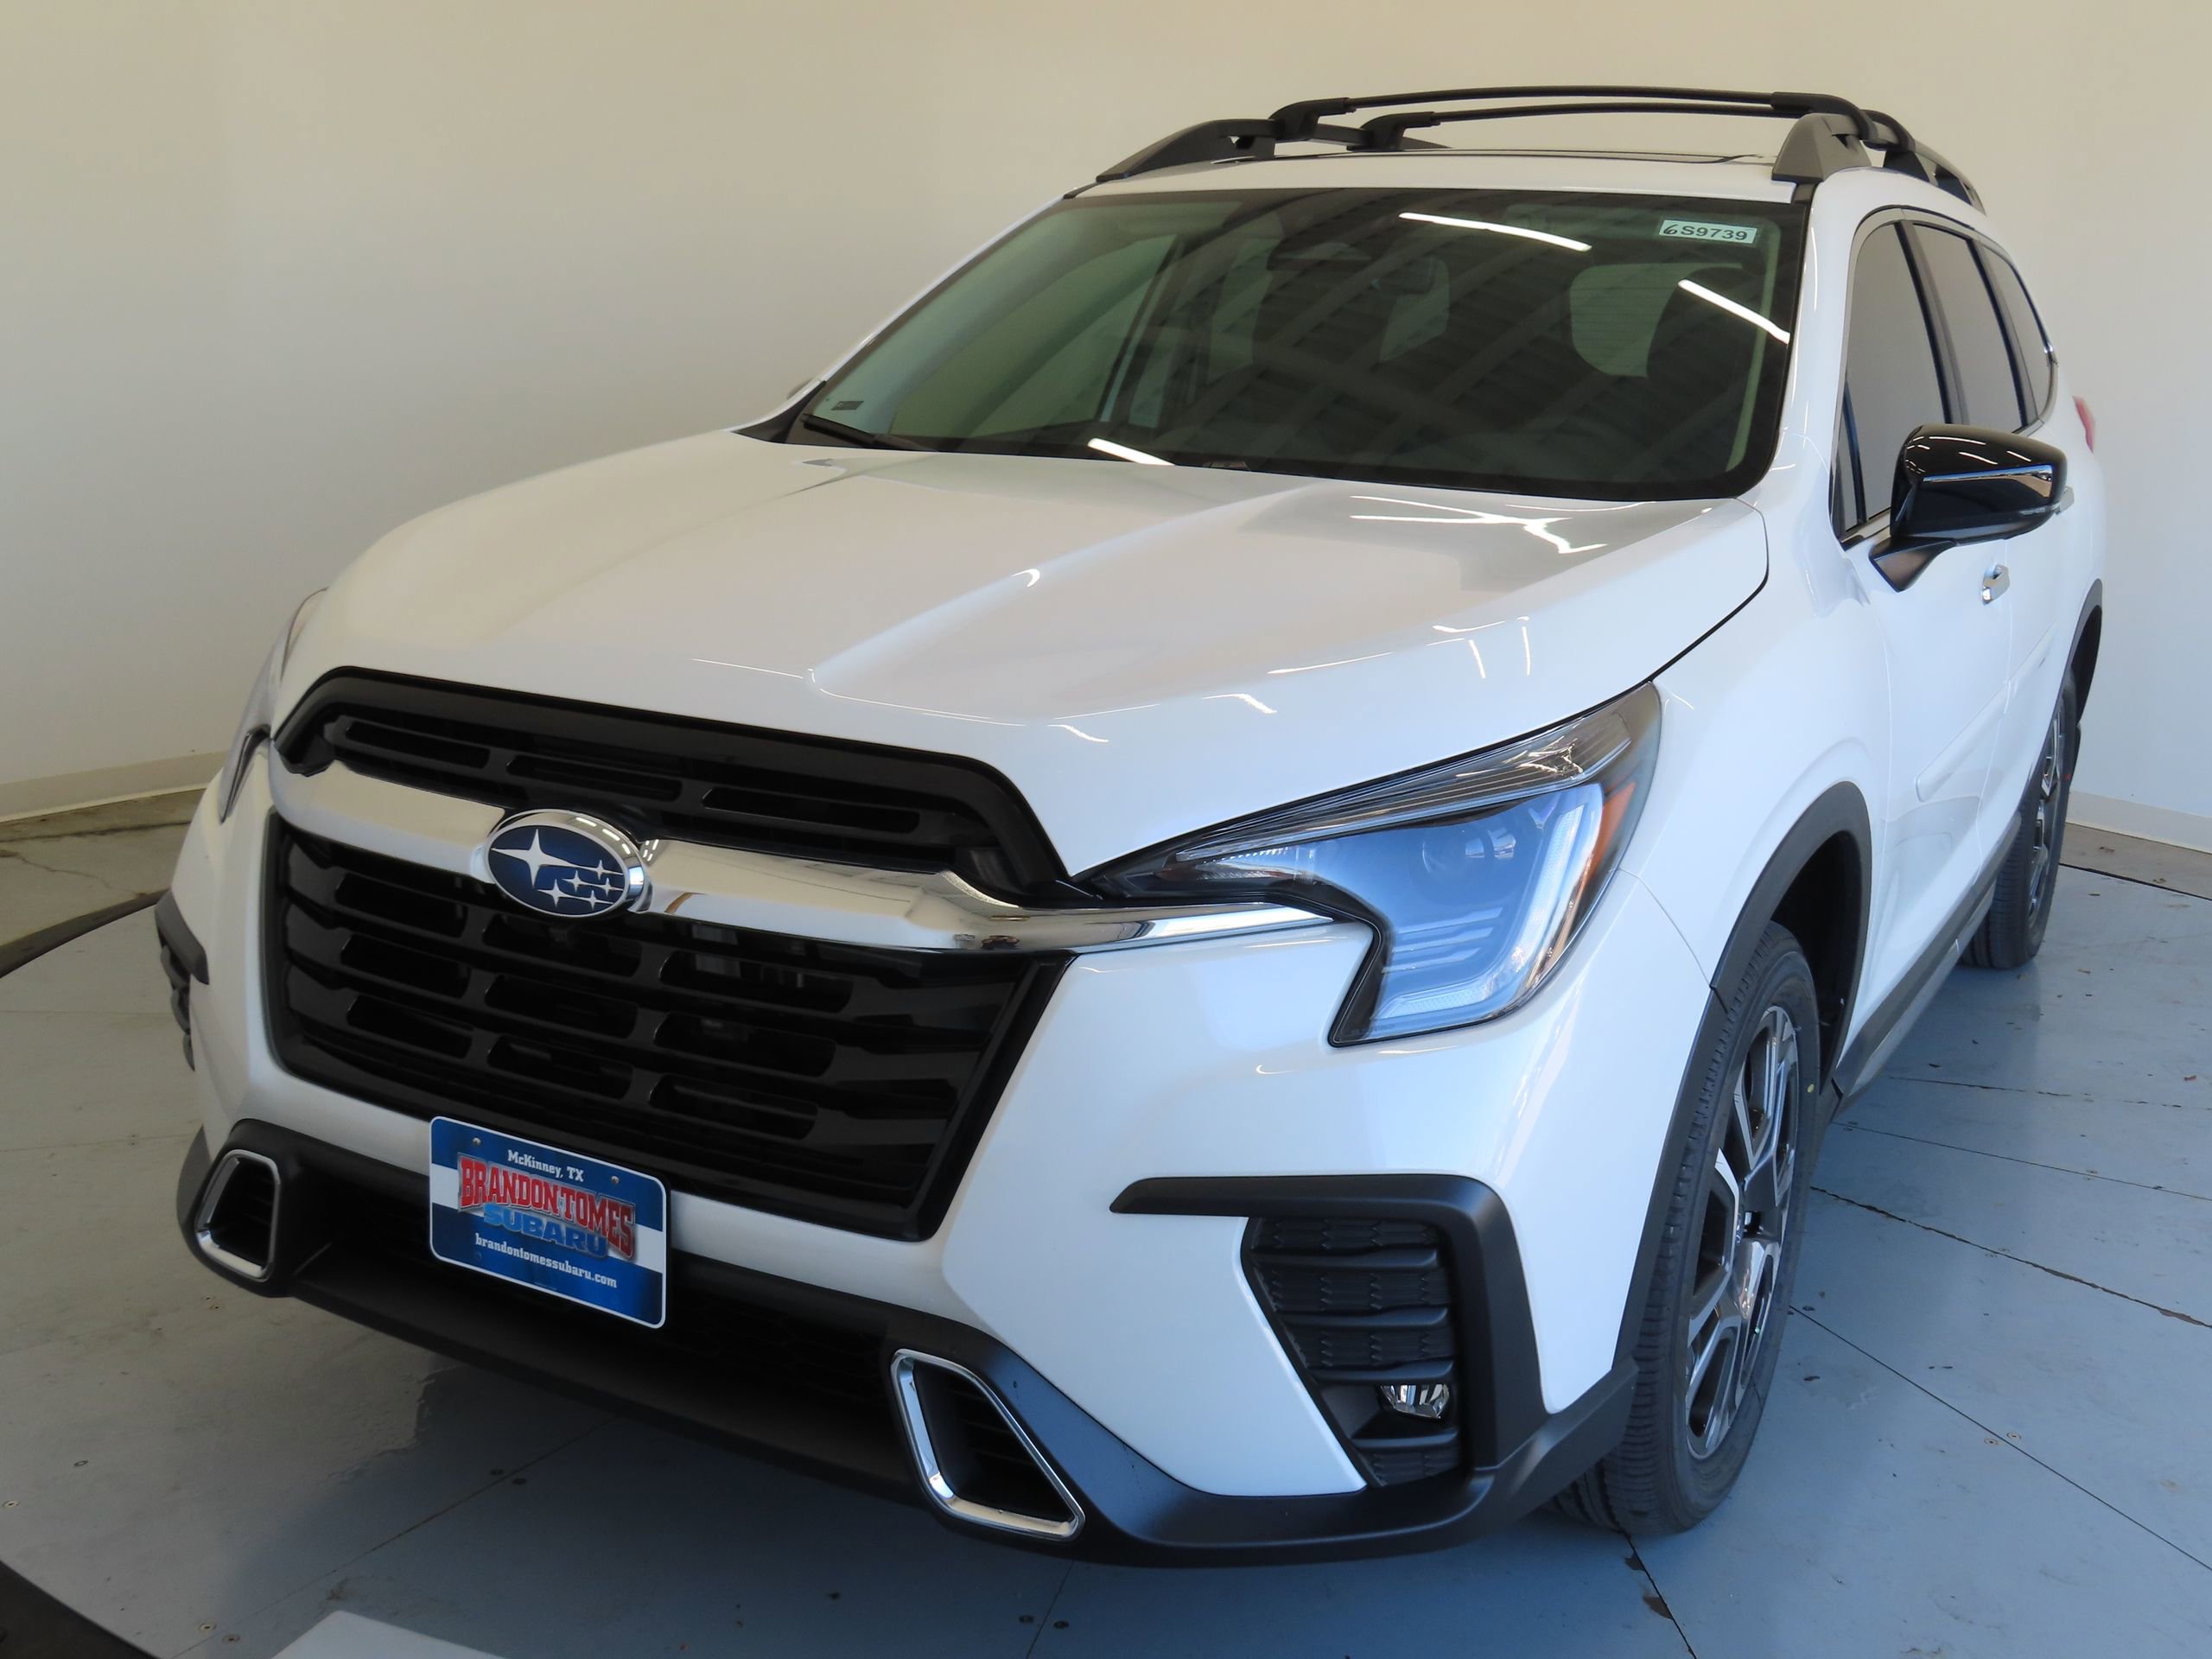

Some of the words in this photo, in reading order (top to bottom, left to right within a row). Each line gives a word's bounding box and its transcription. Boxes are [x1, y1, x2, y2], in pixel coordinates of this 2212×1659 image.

[1662, 224, 1748, 240] 6S9739
[507, 1149, 563, 1179] McKinney,
[567, 1166, 584, 1182] TX
[484, 1202, 608, 1259] SUBARU
[475, 1232, 618, 1288] brandontomessubaru.com
